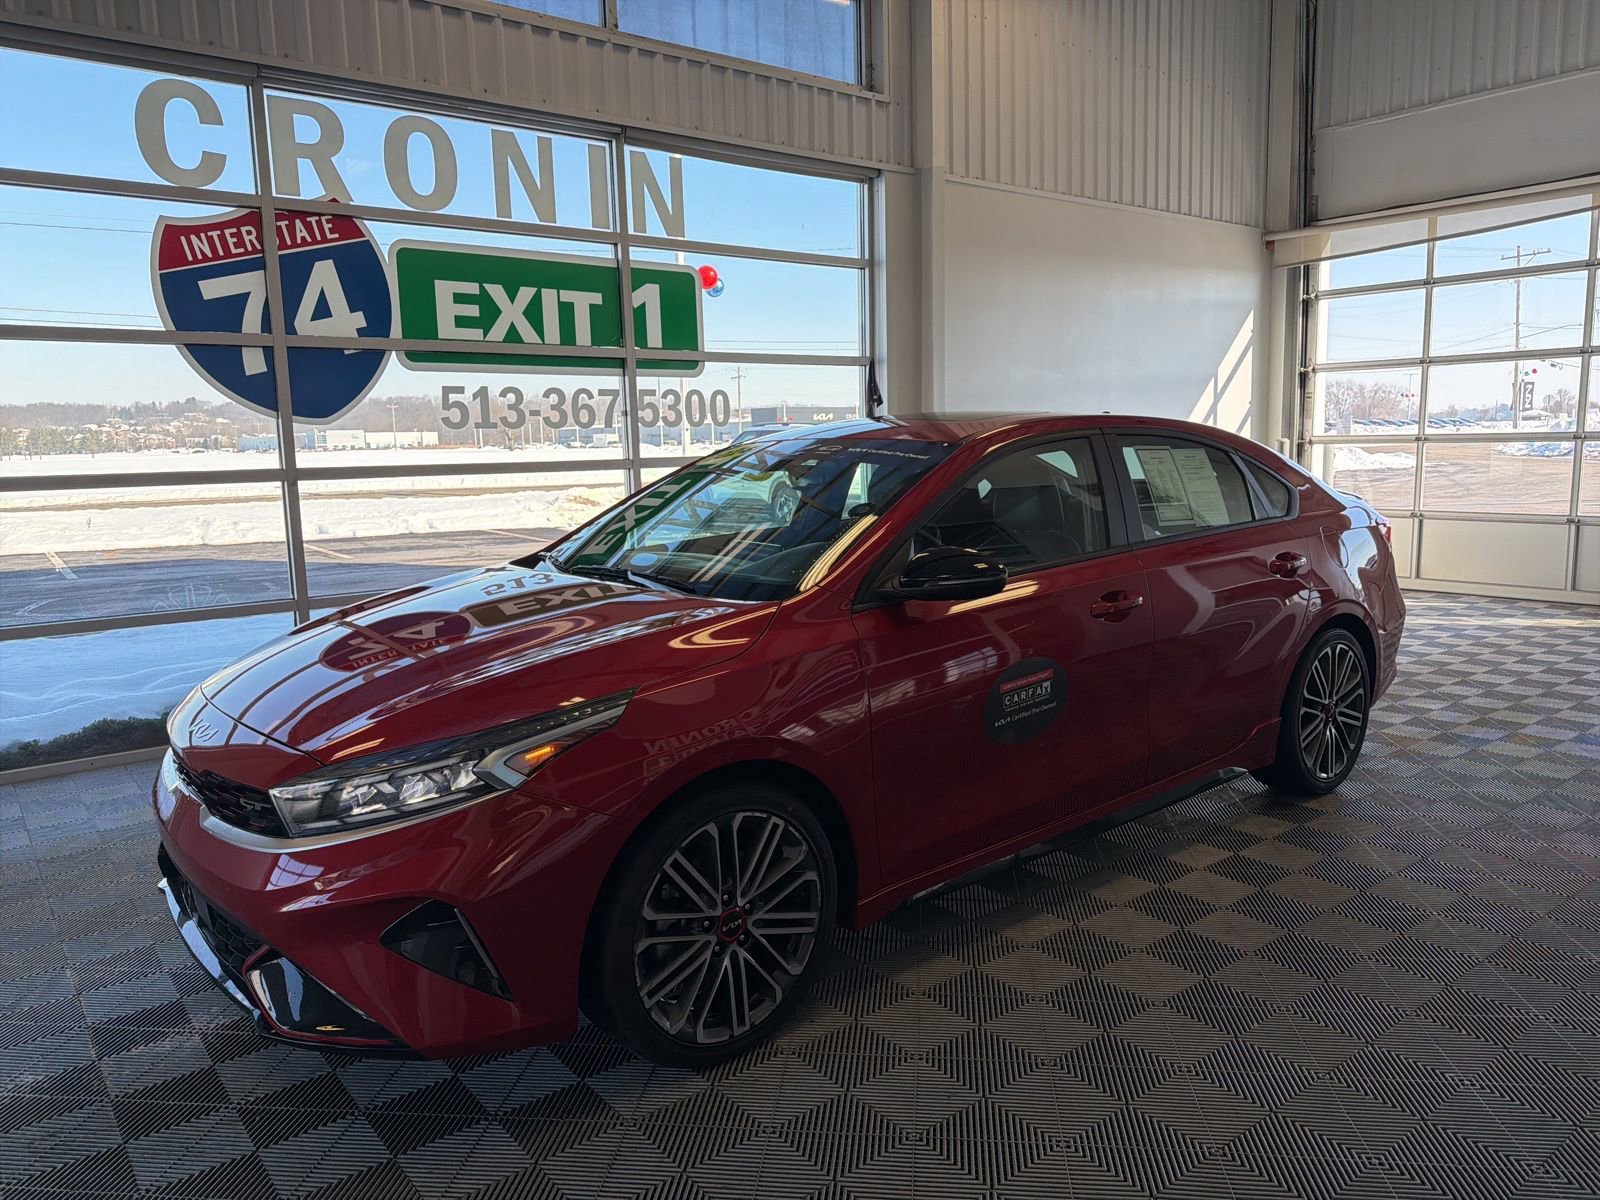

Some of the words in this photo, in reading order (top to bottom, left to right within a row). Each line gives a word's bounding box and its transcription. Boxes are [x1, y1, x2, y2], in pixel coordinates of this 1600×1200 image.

[134, 78, 686, 238] CRONIN
[180, 215, 339, 262] INTERTATE
[197, 258, 368, 376] 74
[434, 279, 603, 347] EXIT
[631, 282, 663, 349] 1
[1003, 680, 1051, 707] CARFAX
[1011, 709, 1032, 722] Certified
[1032, 701, 1057, 716] Pre-Owned
